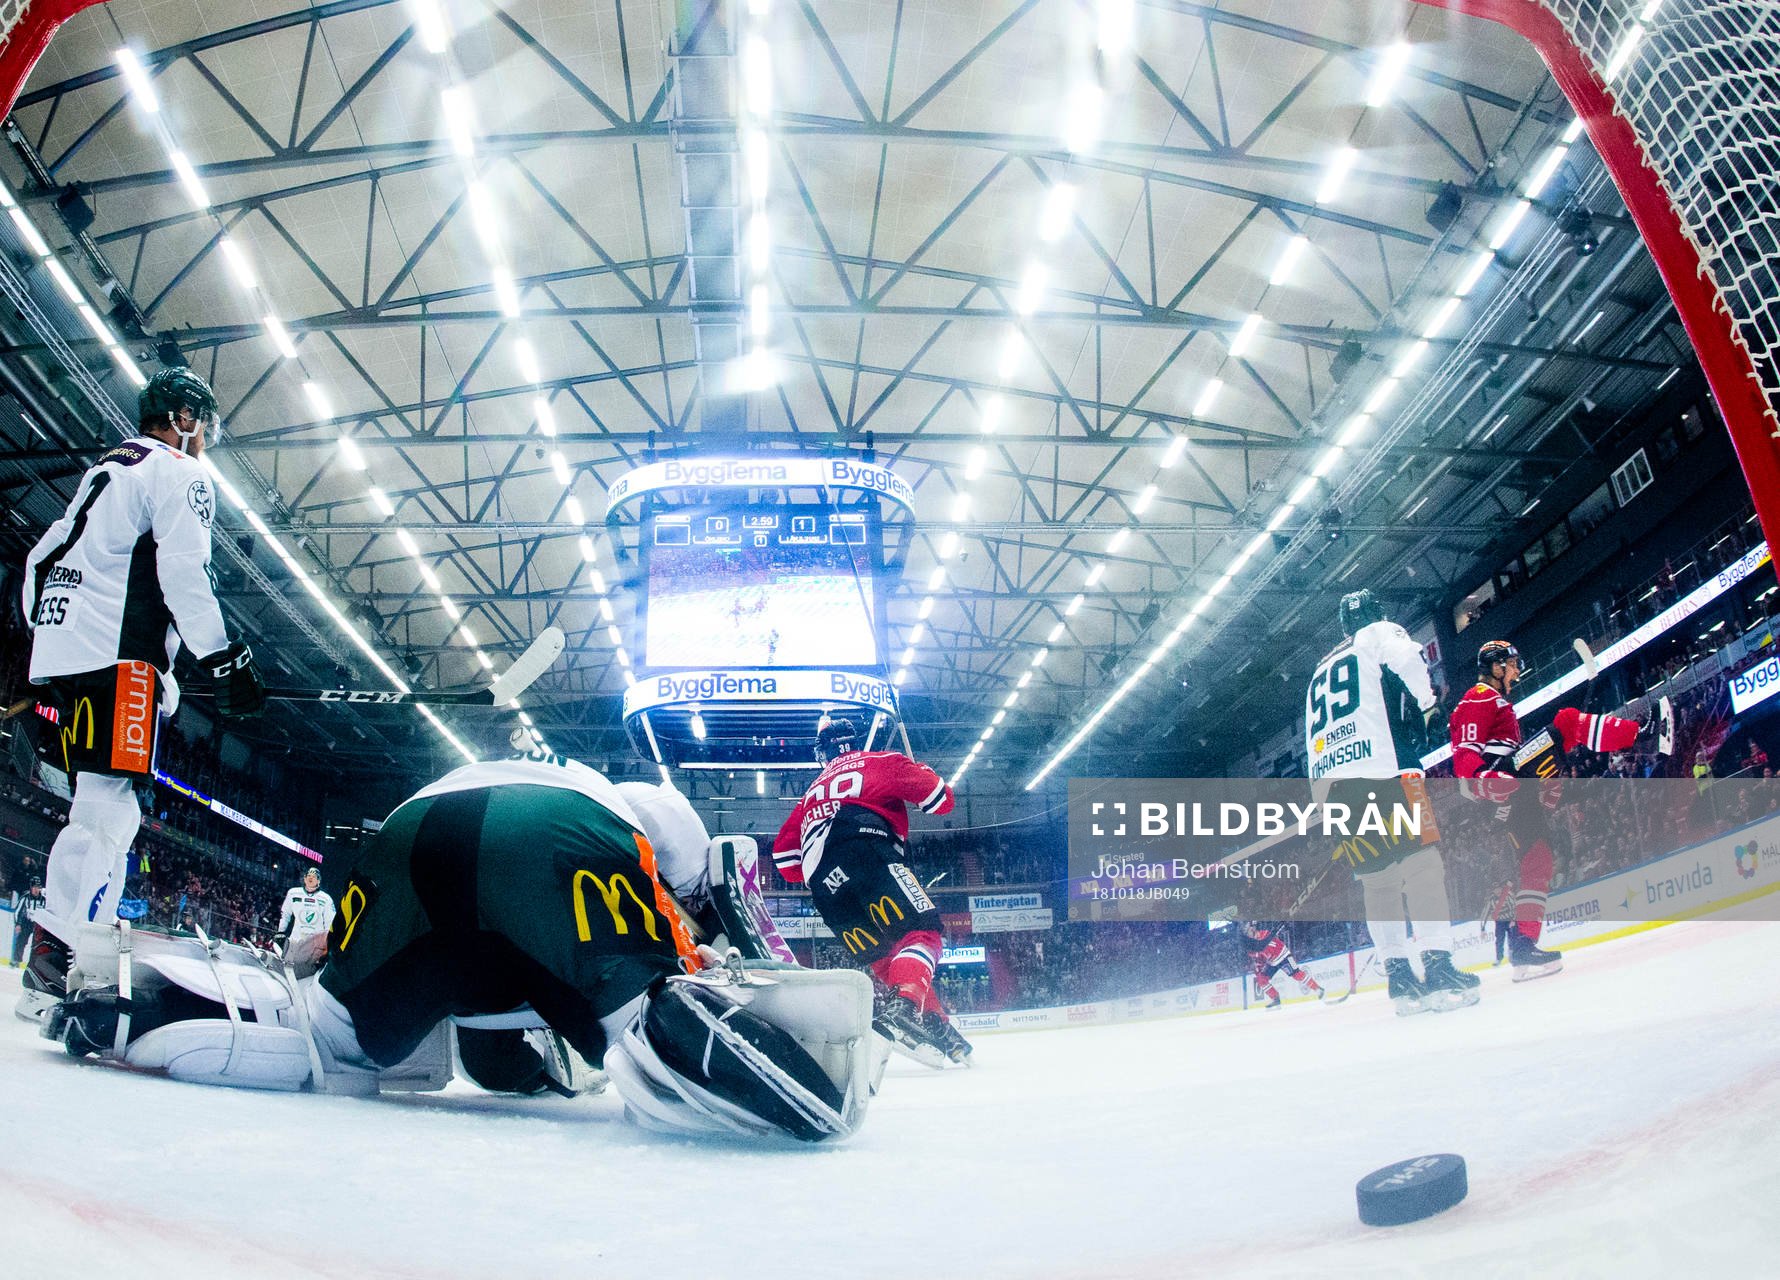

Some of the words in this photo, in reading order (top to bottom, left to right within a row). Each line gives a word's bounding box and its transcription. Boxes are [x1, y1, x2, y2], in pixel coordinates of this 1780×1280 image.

[665, 462, 787, 484] ByggTema
[751, 517, 773, 526] 2.59
[1718, 546, 1770, 587] ByggTema
[1349, 599, 1360, 610] 59
[212, 645, 252, 678] CC
[657, 673, 777, 700] ByggTema
[1735, 660, 1780, 696] Bygg
[319, 689, 405, 703] CCM
[1310, 653, 1361, 740] 59
[1326, 721, 1356, 746] ENERGI
[1461, 723, 1478, 742] 18
[839, 743, 850, 753] 39
[822, 866, 850, 894] NA
[1645, 862, 1713, 904] bravida
[974, 896, 1037, 909] Vintergatan
[1547, 899, 1600, 926] PISCATOR
